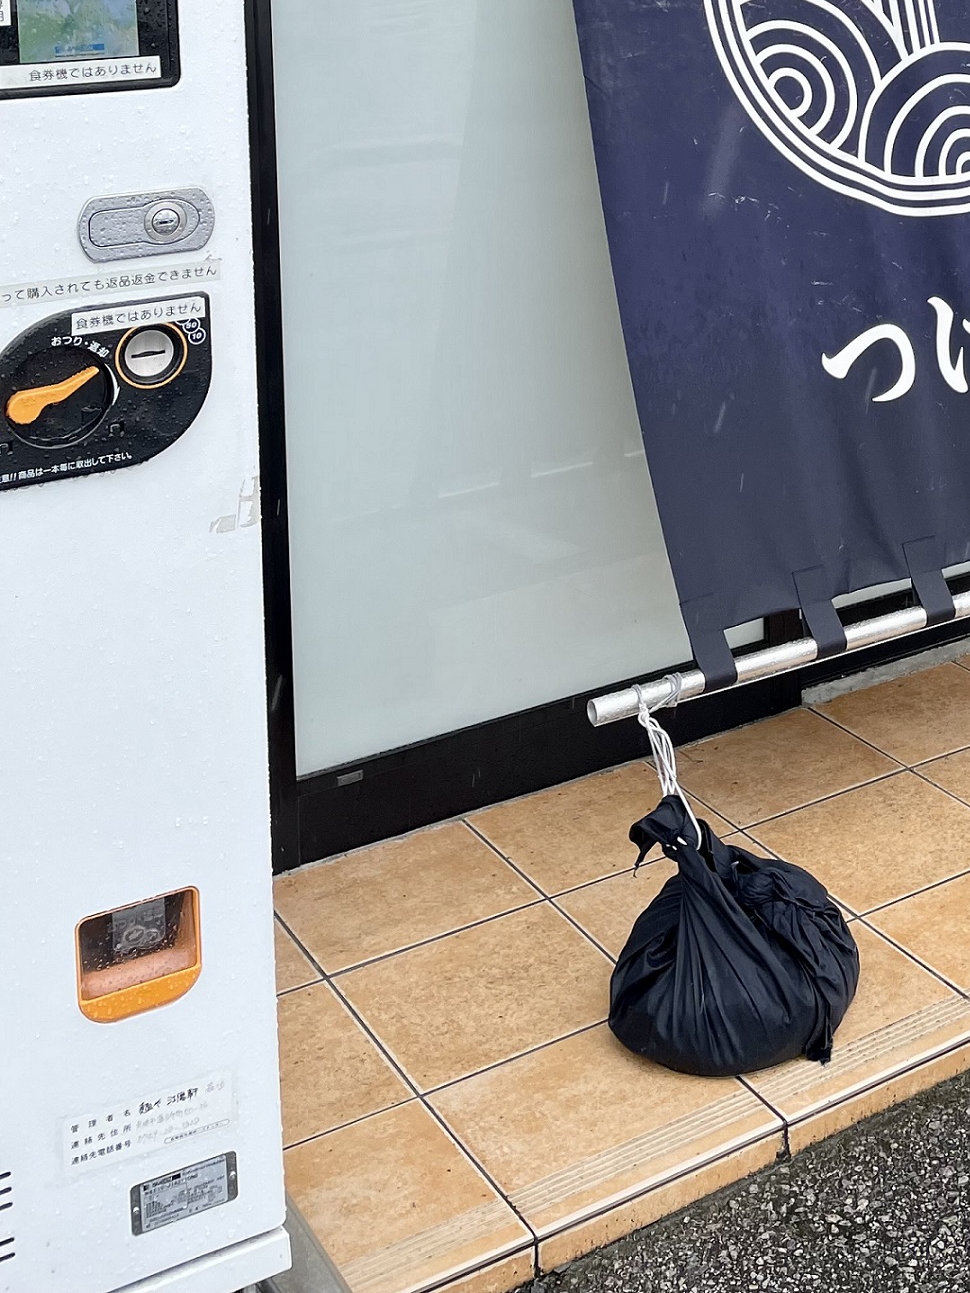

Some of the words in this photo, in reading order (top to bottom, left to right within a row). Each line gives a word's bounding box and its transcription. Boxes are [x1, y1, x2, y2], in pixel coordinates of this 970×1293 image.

[29, 65, 157, 83] 食券機ではありません
[76, 302, 201, 330] 食券機ではありません
